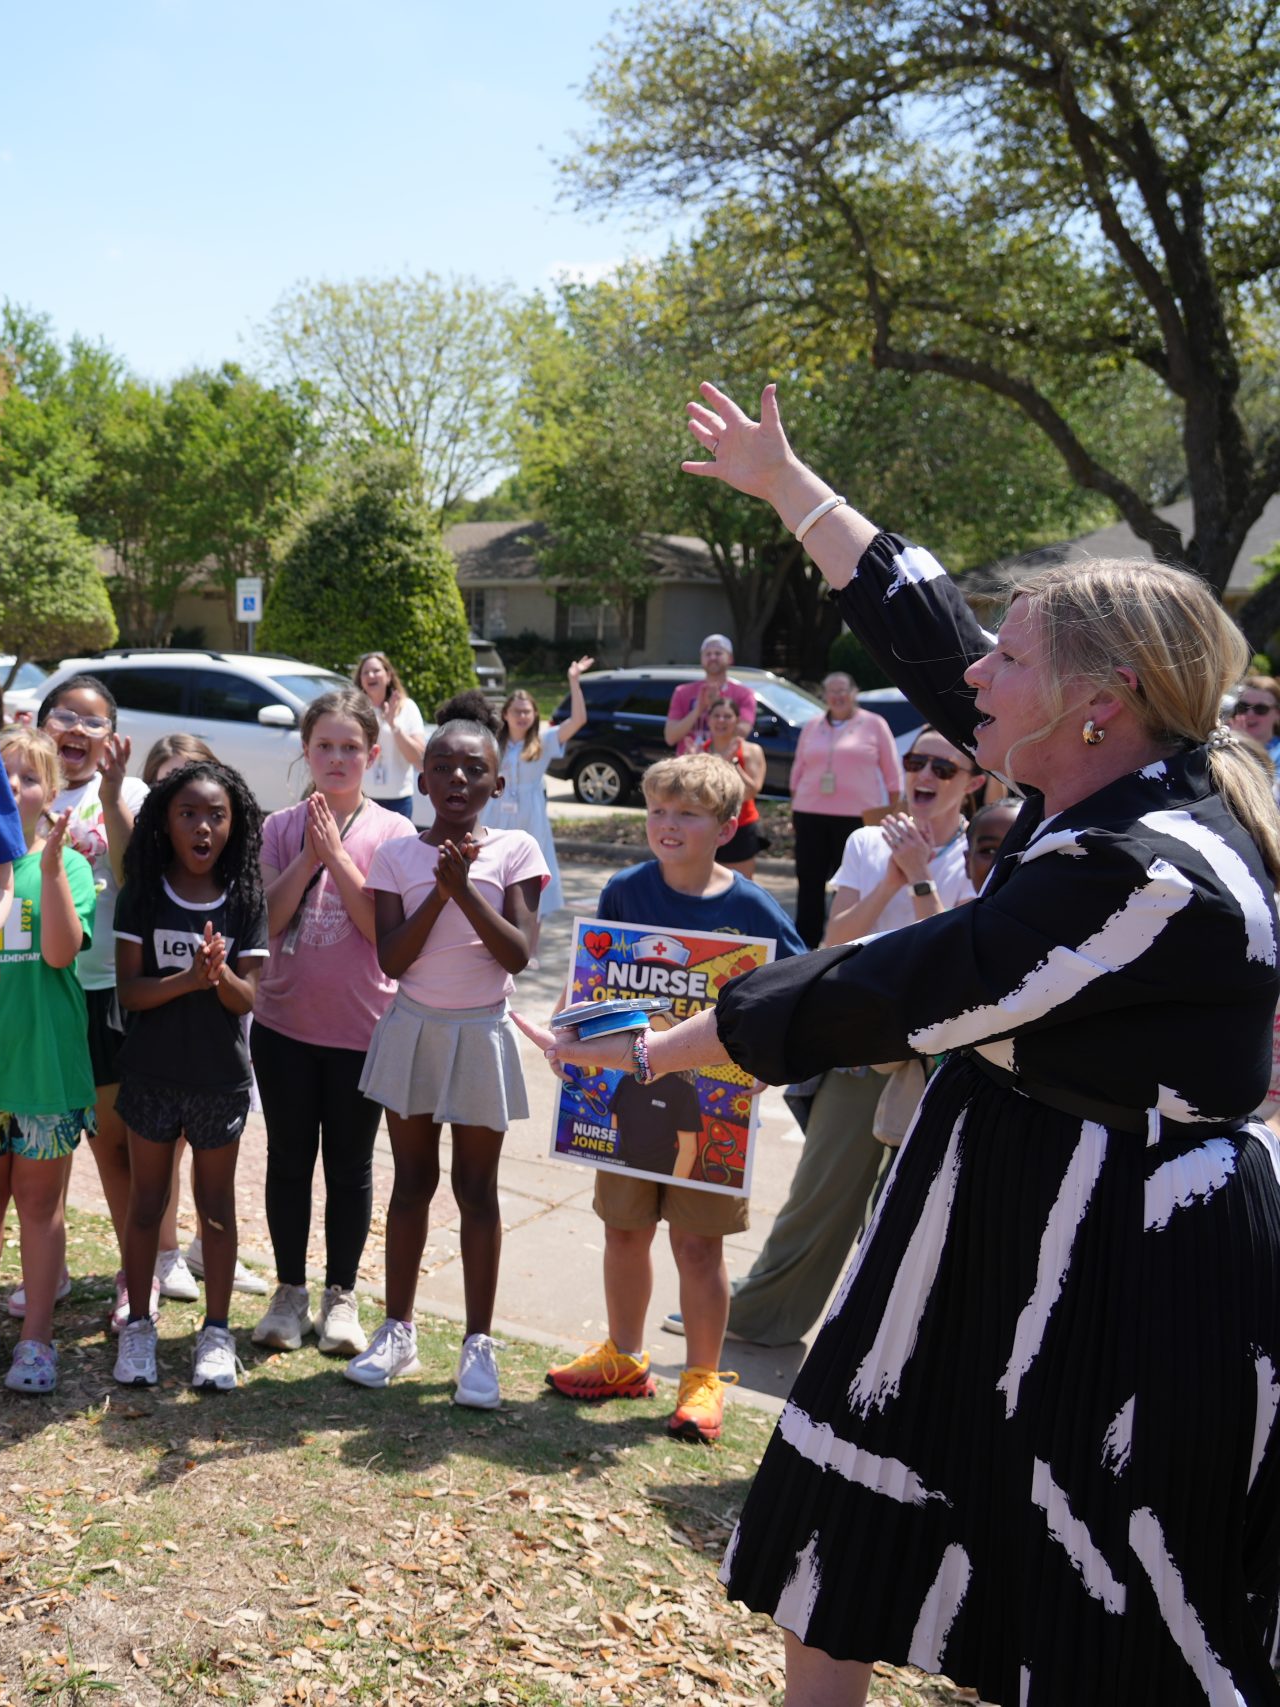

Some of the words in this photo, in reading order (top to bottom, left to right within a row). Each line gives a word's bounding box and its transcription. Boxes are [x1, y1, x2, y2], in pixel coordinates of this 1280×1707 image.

[21, 899, 33, 931] 2026
[607, 961, 708, 998] NURSE
[571, 1135, 614, 1153] JONES
[573, 1122, 617, 1142] NURSE
